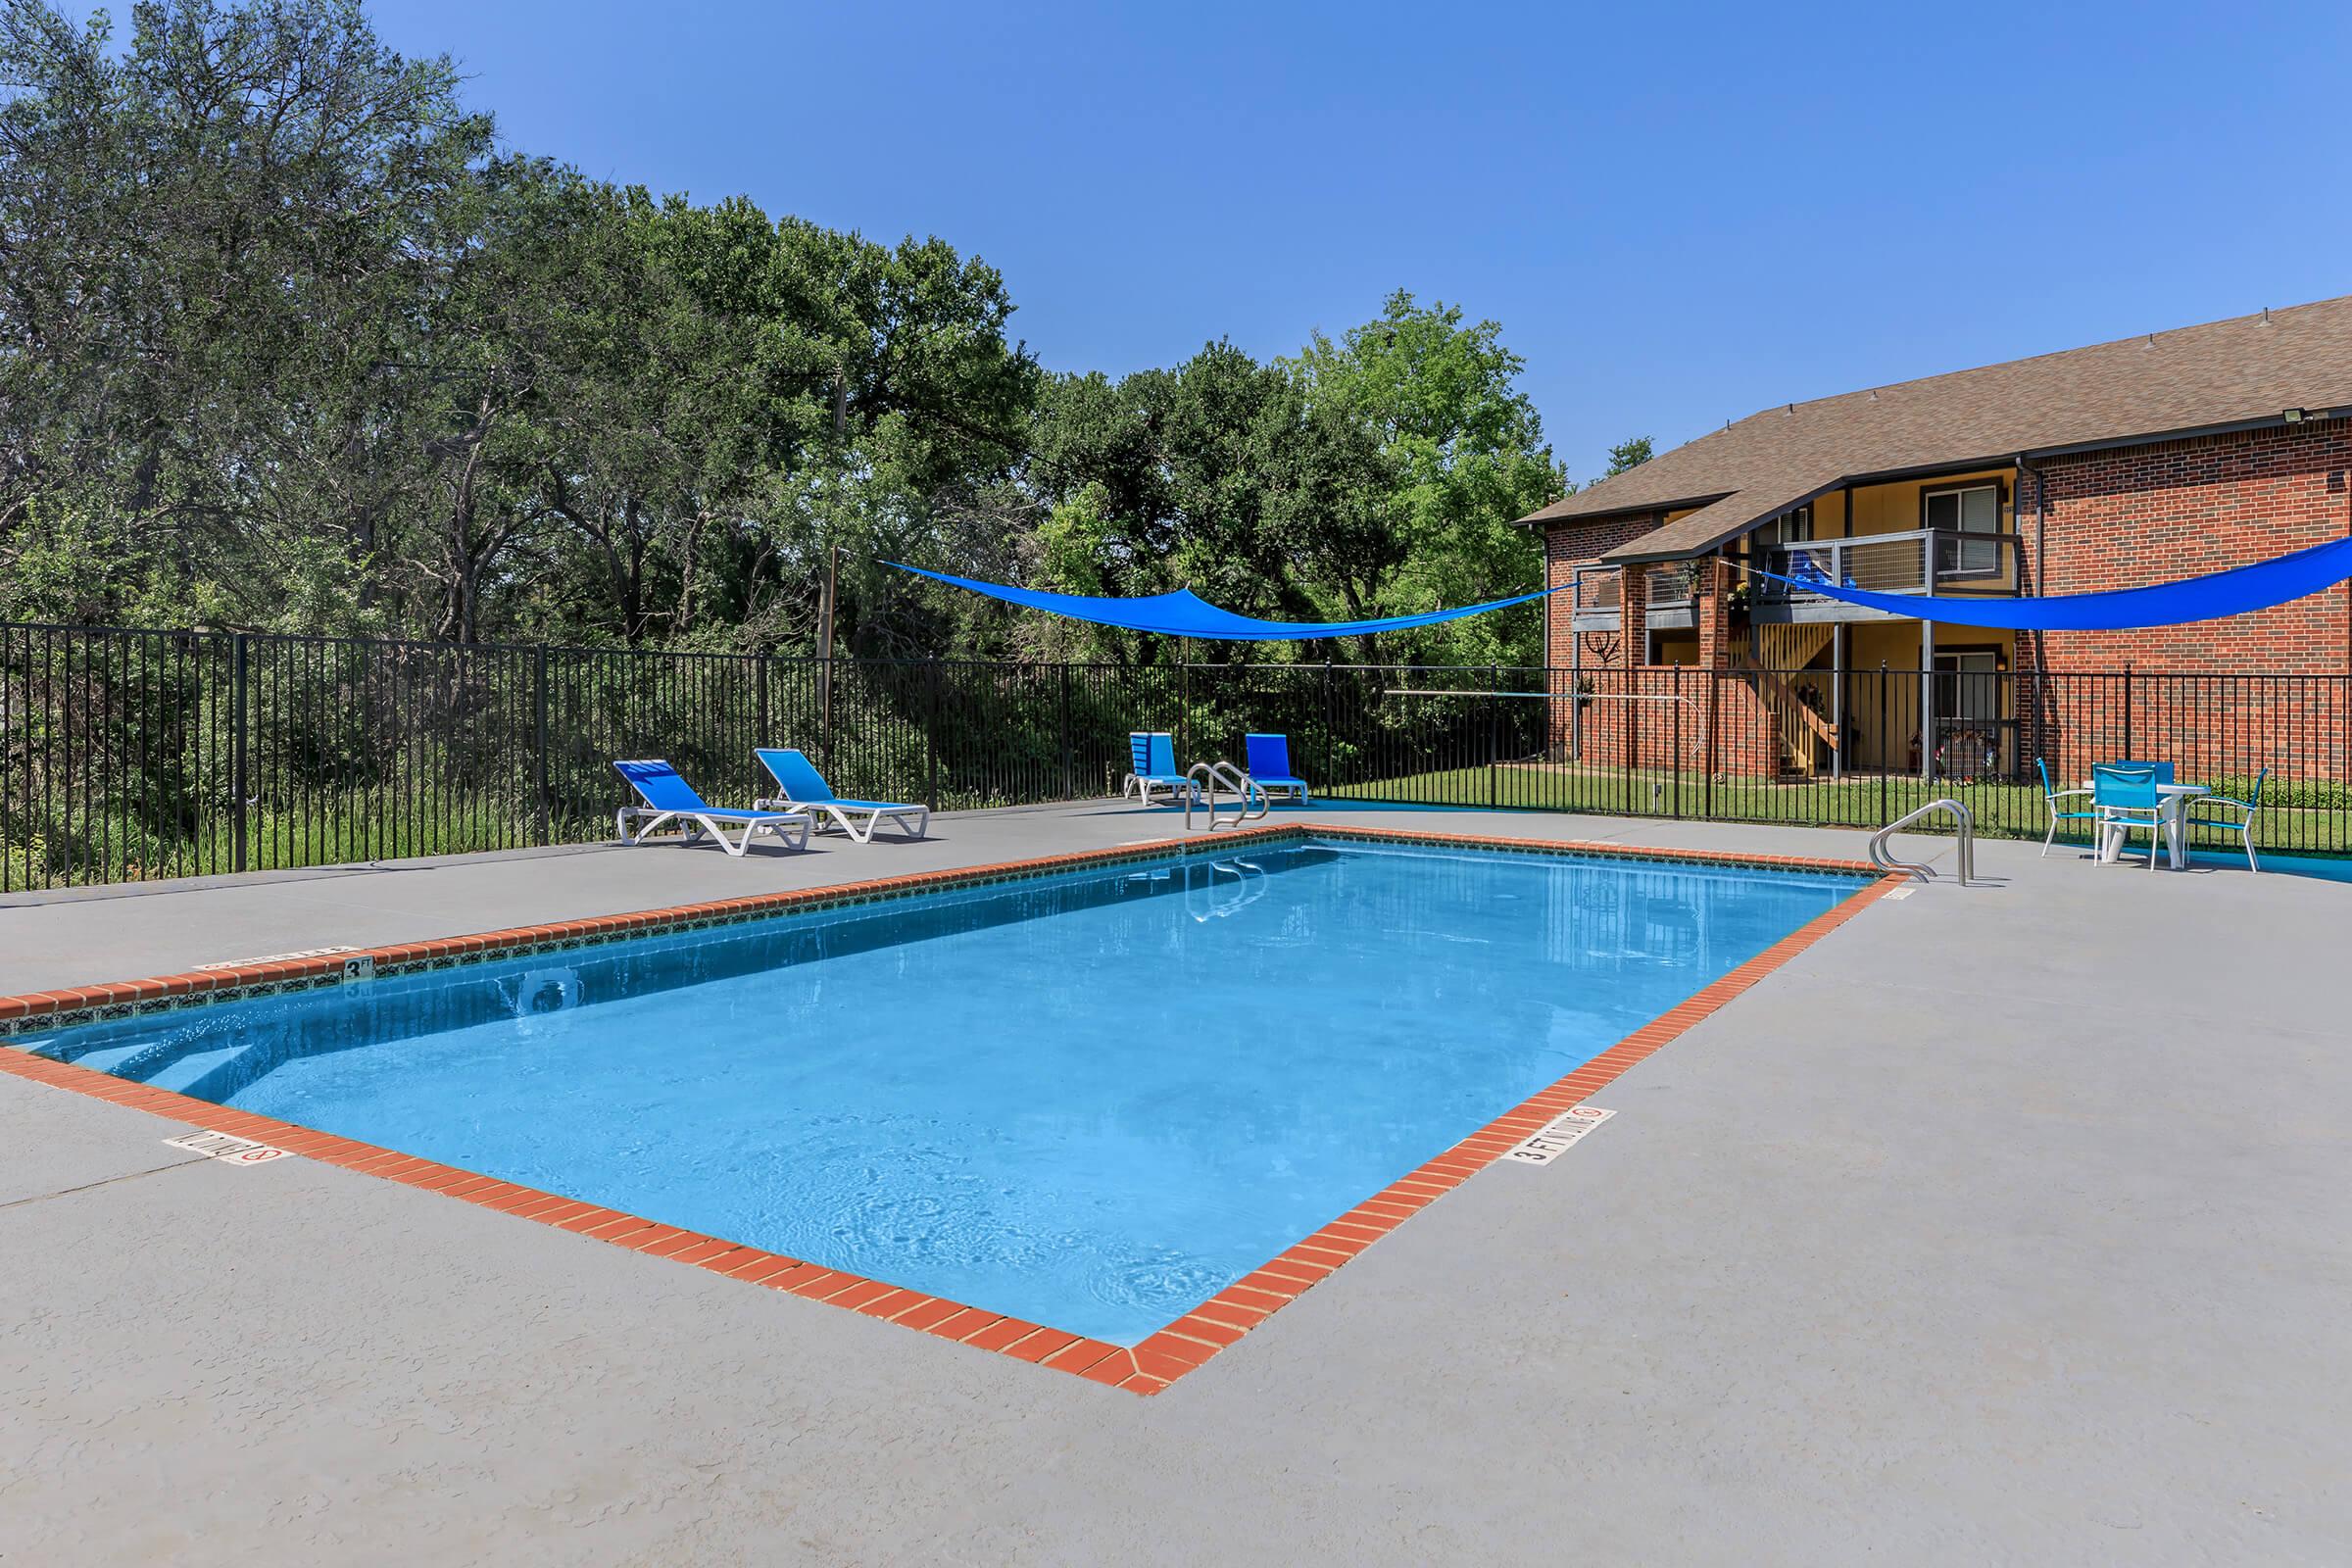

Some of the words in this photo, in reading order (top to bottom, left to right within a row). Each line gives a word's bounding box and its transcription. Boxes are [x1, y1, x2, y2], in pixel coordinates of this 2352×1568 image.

[347, 961, 360, 977] 3
[361, 958, 370, 967] FT
[1526, 1138, 1565, 1152] FT
[1513, 1151, 1546, 1160] 3
